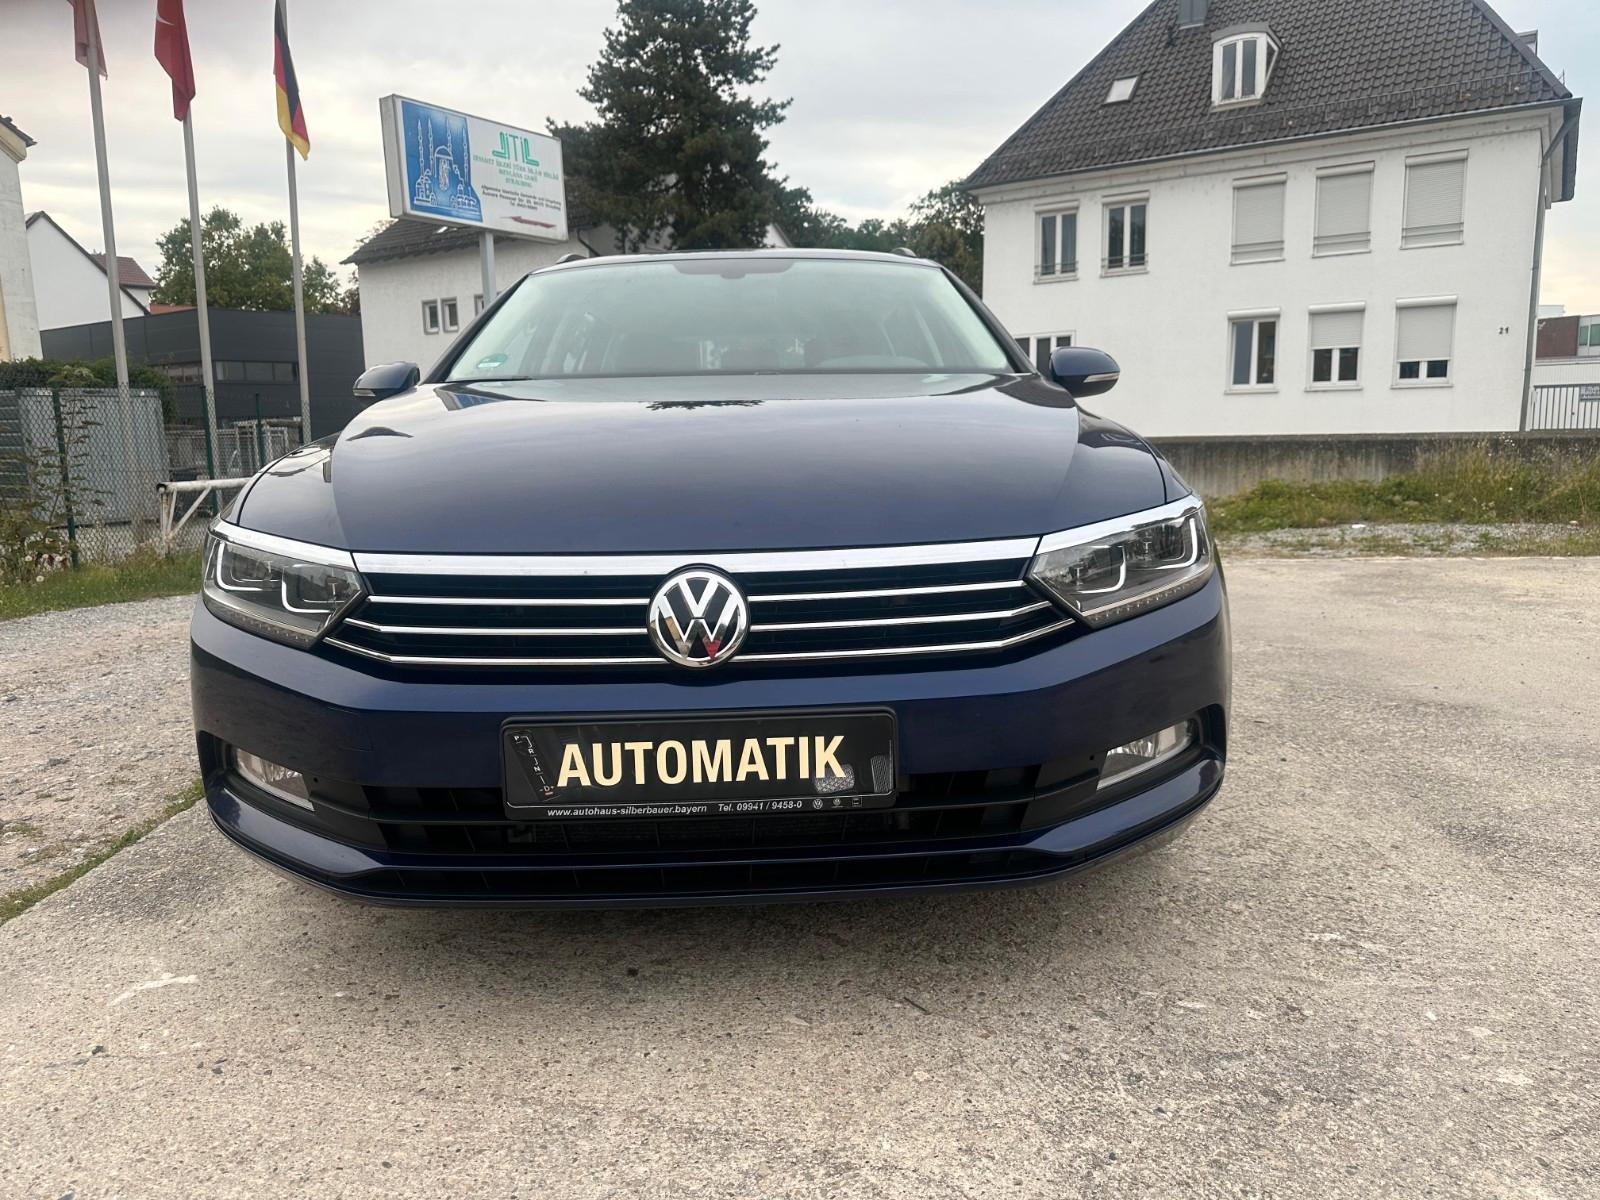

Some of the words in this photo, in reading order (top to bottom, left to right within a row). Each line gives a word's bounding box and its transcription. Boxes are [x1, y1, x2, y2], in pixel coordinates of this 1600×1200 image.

[1498, 327, 1509, 335] 21
[557, 735, 846, 788] AUTOMATIK
[547, 804, 707, 817] www.autohaus-silberbauer.bayern
[718, 803, 734, 812] Tel.
[736, 802, 763, 812] 09941
[772, 800, 803, 811] 9458-0
